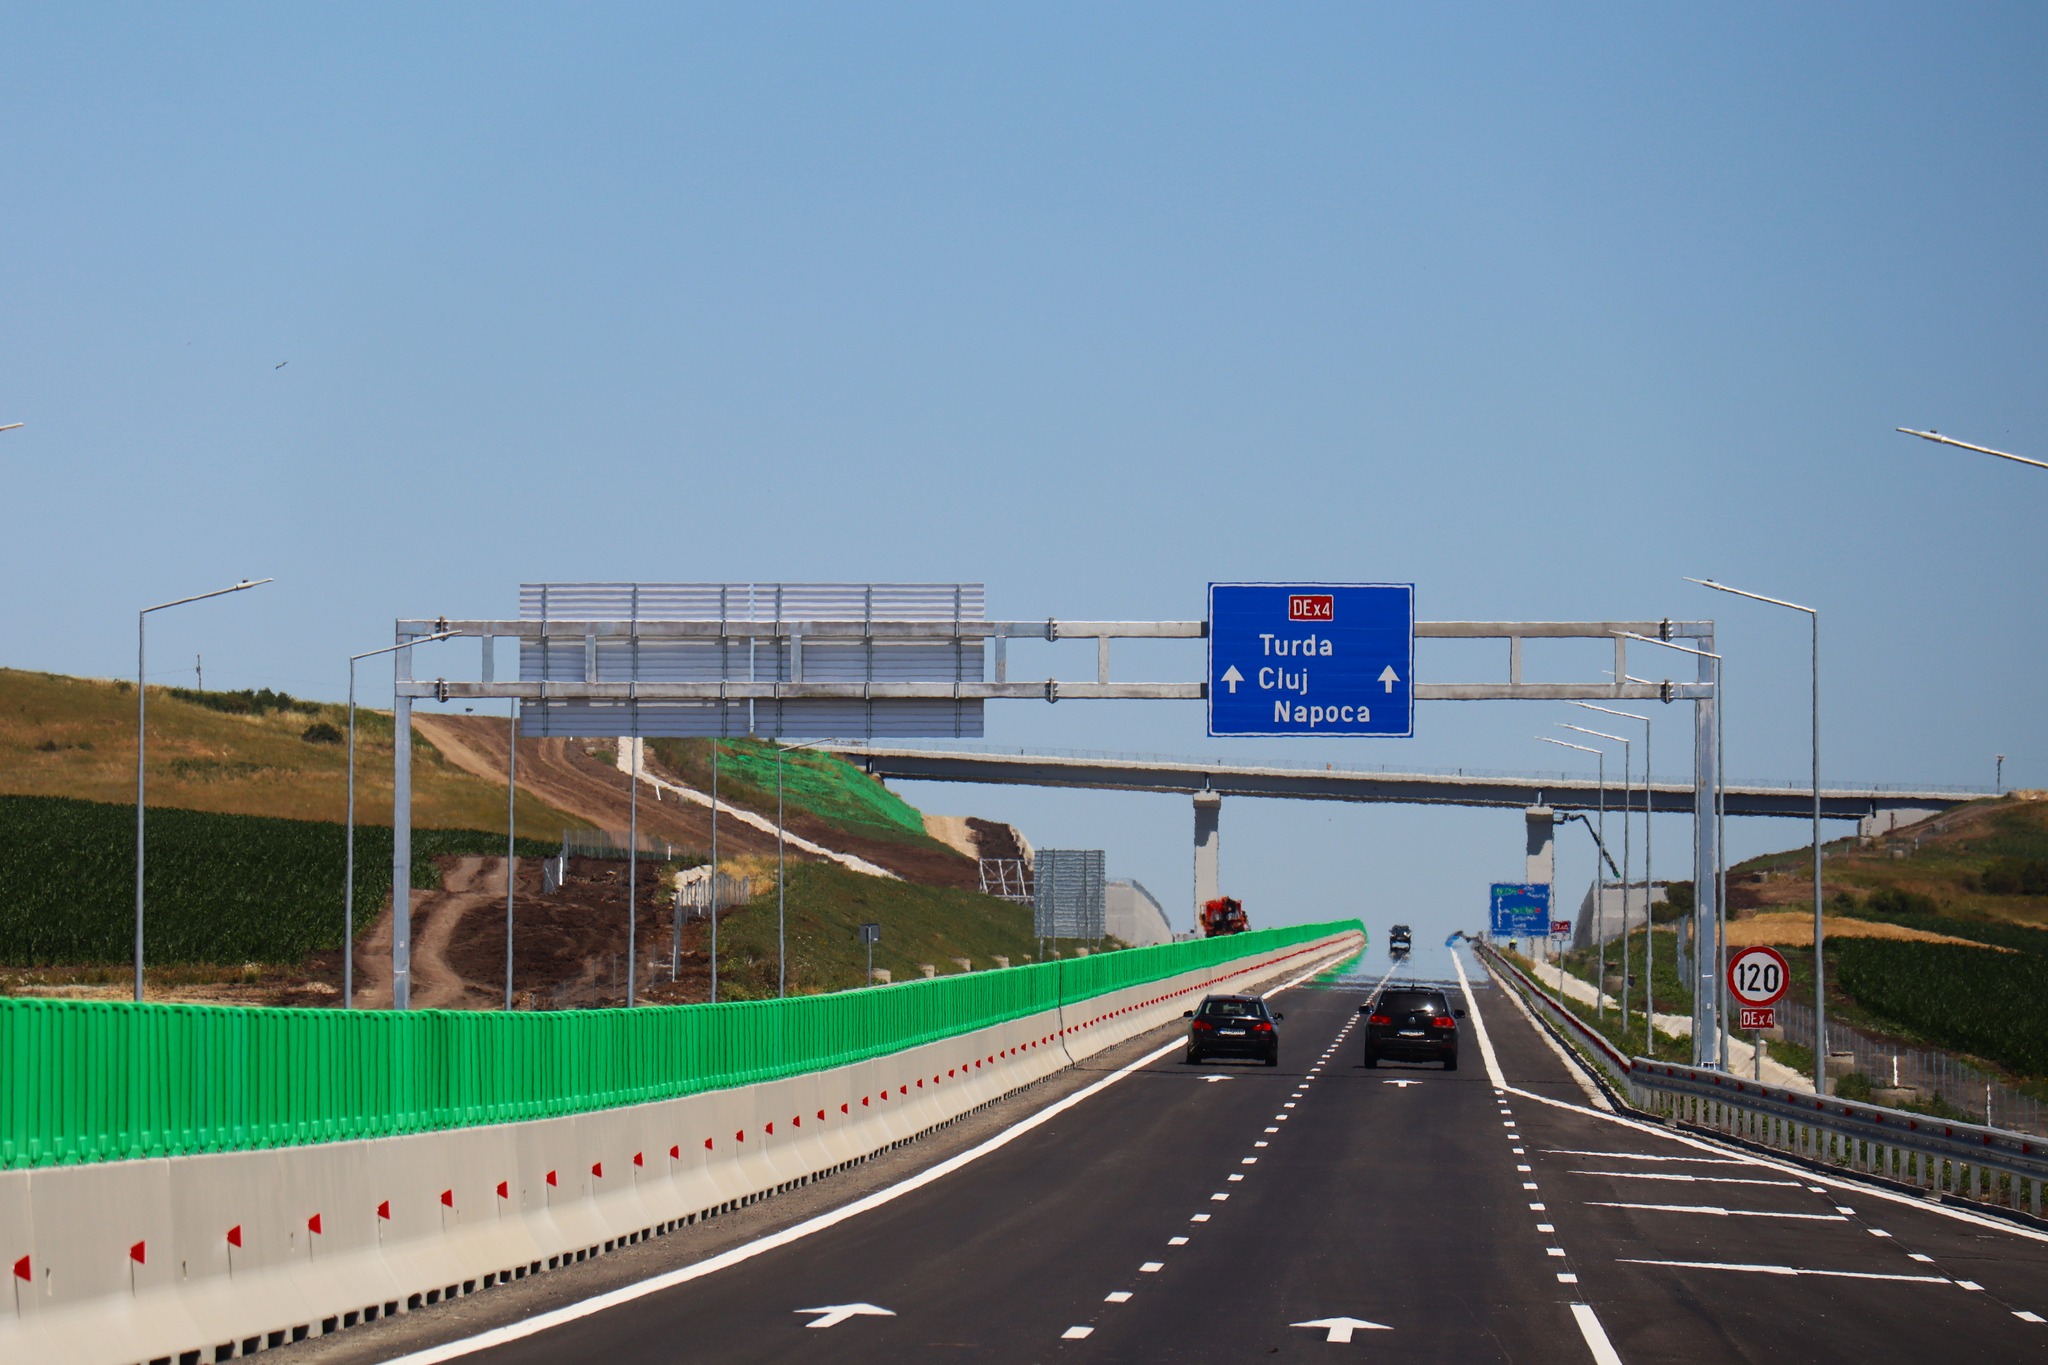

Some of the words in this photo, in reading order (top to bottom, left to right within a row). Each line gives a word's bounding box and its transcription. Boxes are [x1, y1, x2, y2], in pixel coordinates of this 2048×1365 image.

[1293, 599, 1331, 617] DEx4
[1259, 634, 1333, 656] Turda
[1258, 667, 1308, 695] Cluj
[1274, 701, 1371, 727] Napoca
[1738, 963, 1779, 993] 120
